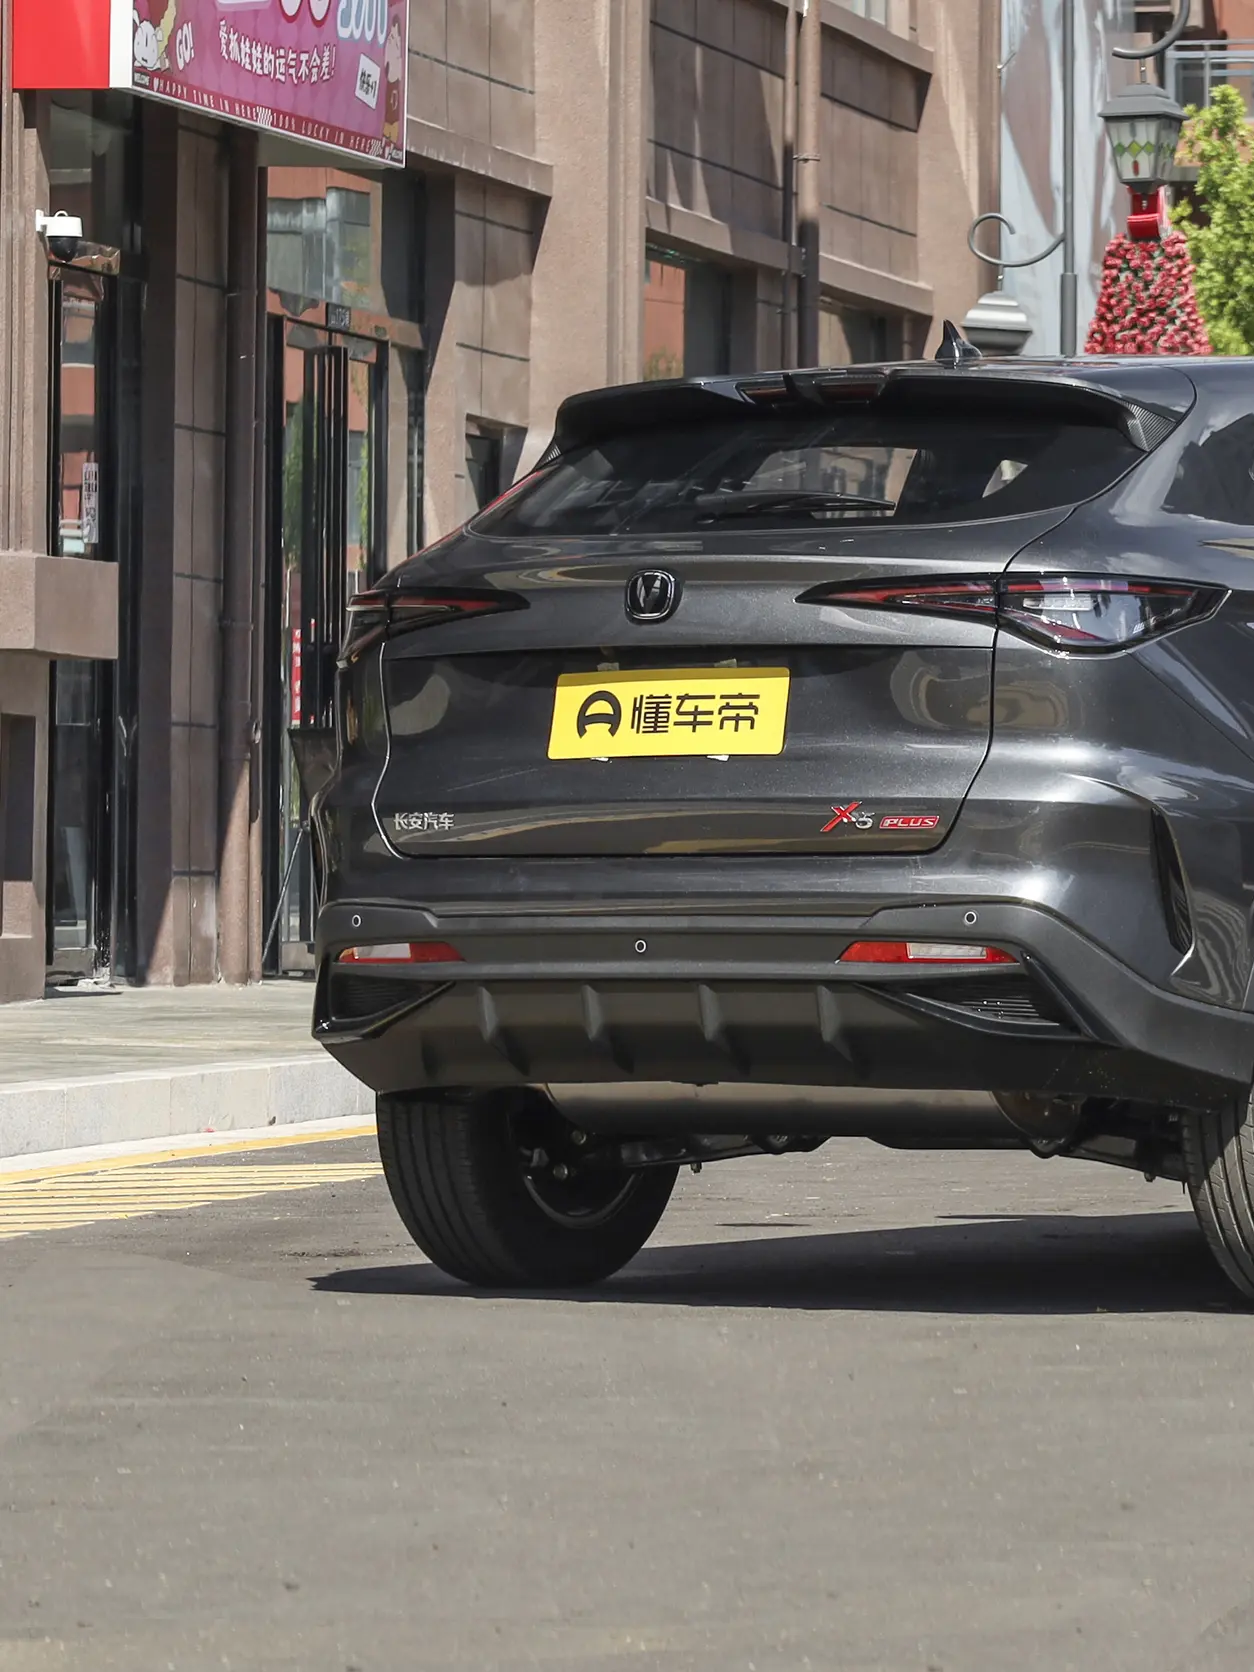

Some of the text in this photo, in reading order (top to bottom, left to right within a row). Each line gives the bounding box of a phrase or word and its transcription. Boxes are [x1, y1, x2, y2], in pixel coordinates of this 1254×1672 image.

[176, 22, 195, 70] GO!
[160, 79, 257, 120] HAPPY TIME IN HERE
[302, 121, 329, 140] LUCKY
[334, 131, 344, 144] IN
[349, 135, 371, 153] HERE
[631, 692, 760, 734] 懂车帝
[393, 812, 455, 830] 长安汽车
[820, 801, 937, 832] X5 PLUS
